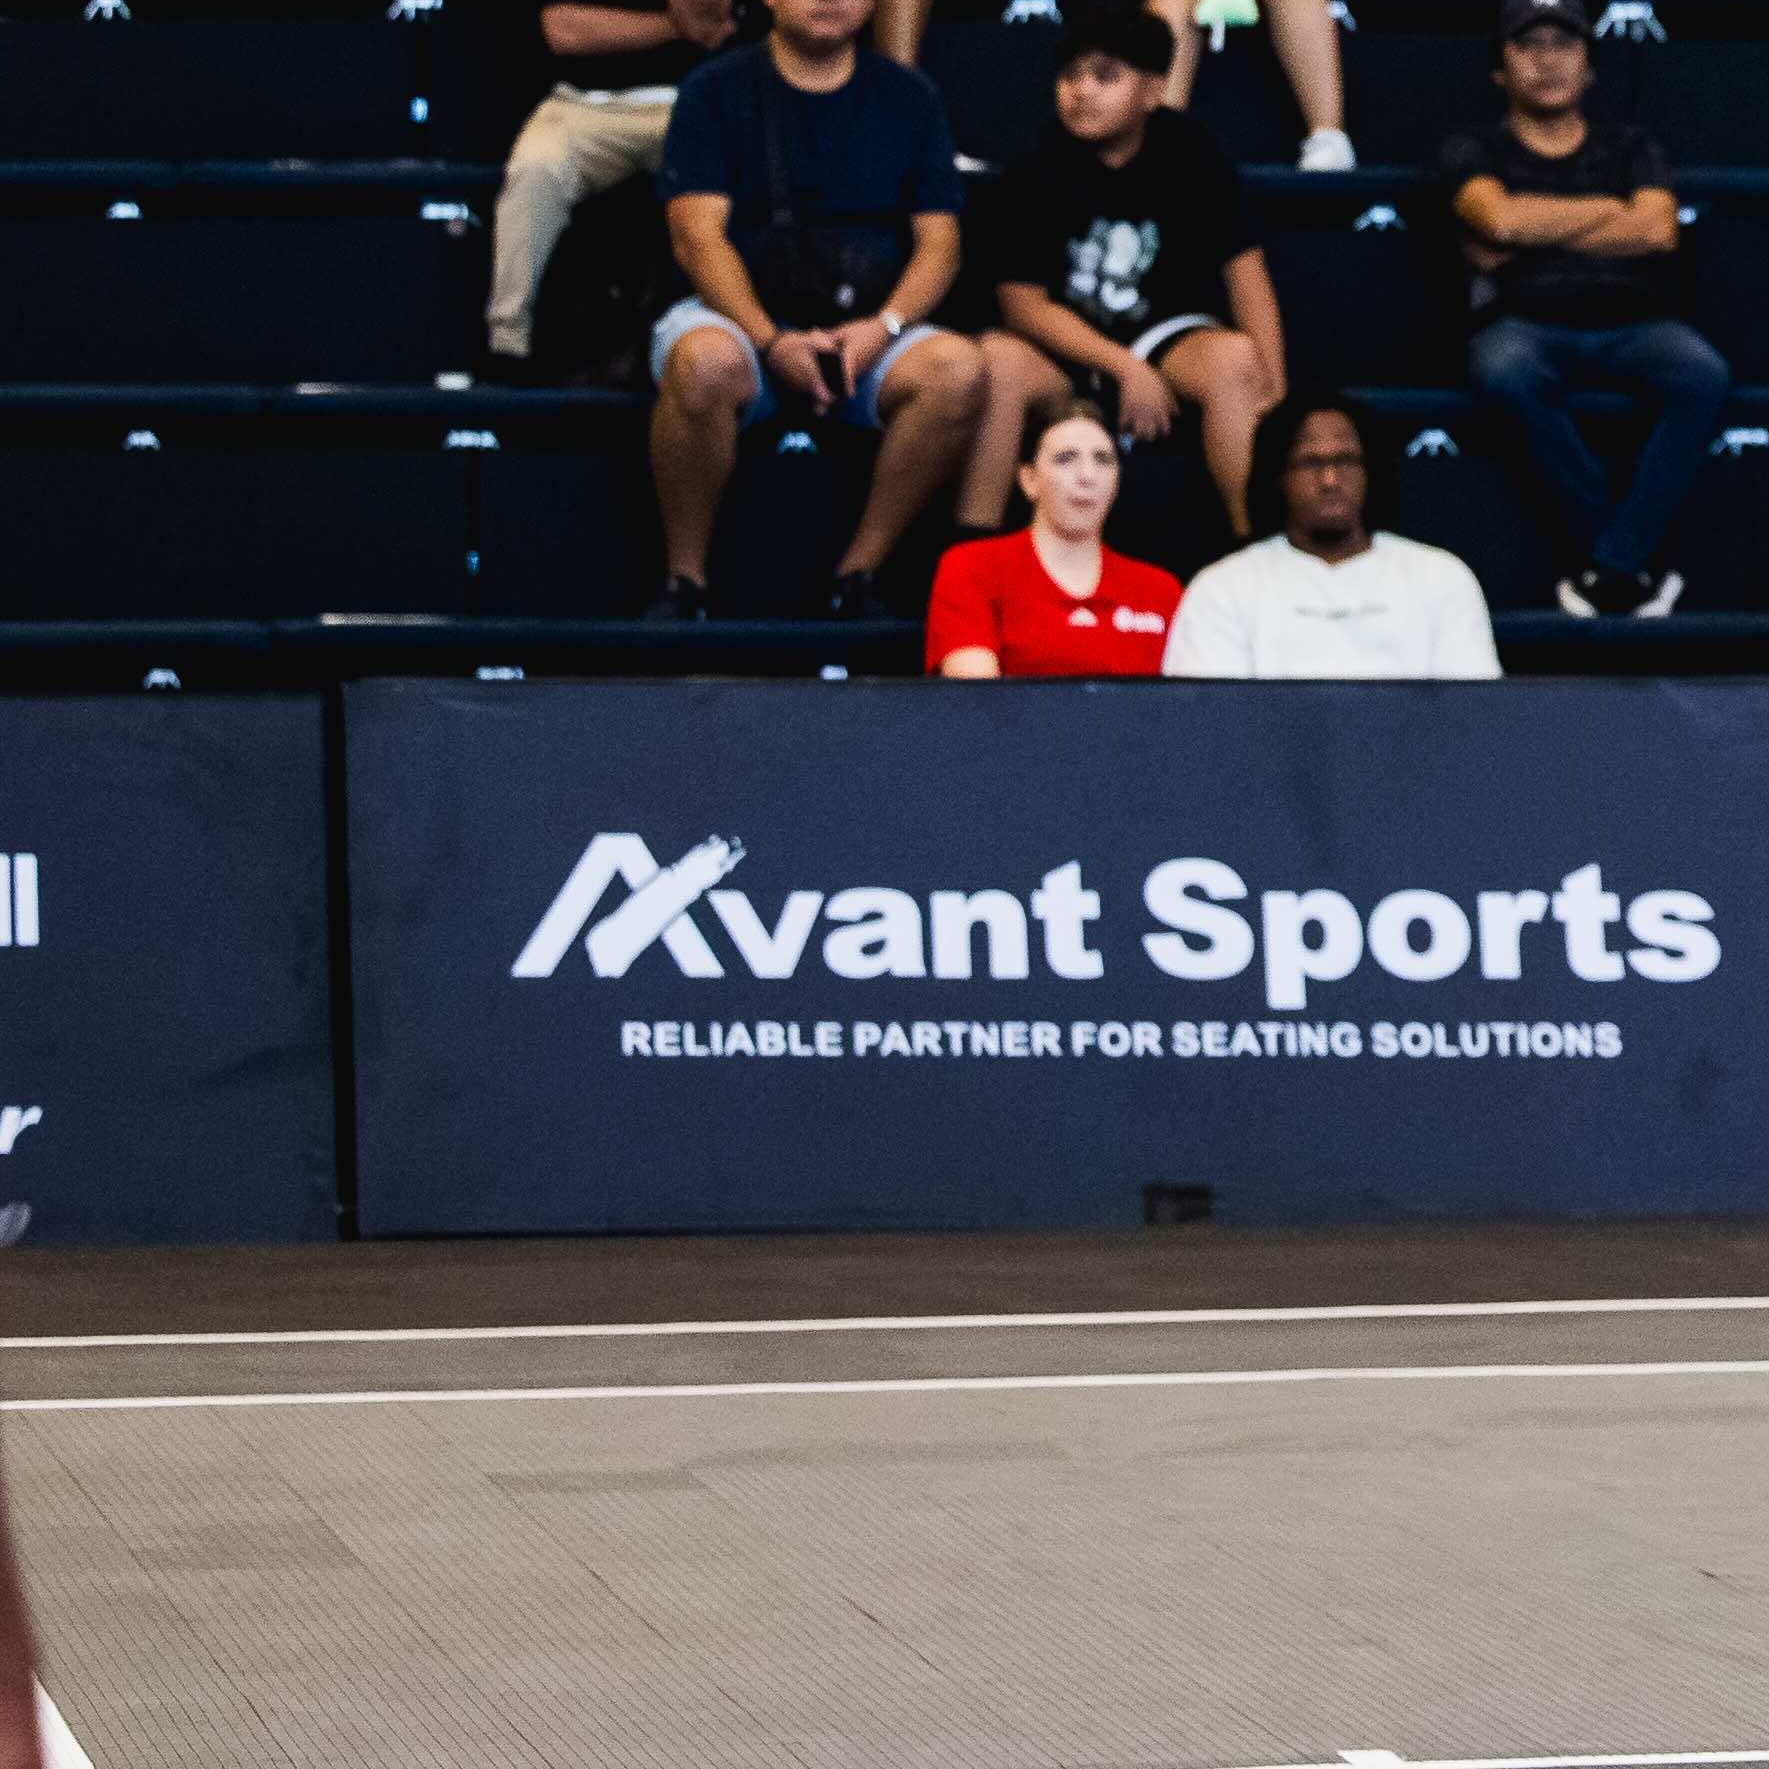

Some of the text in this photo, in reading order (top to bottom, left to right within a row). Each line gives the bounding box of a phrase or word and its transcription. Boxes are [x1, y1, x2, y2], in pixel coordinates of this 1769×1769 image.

[510, 832, 1722, 1011] Avant Sports
[621, 1020, 1624, 1059] RELIABLE PARTNER FOR SEATING SOLUTIONS
